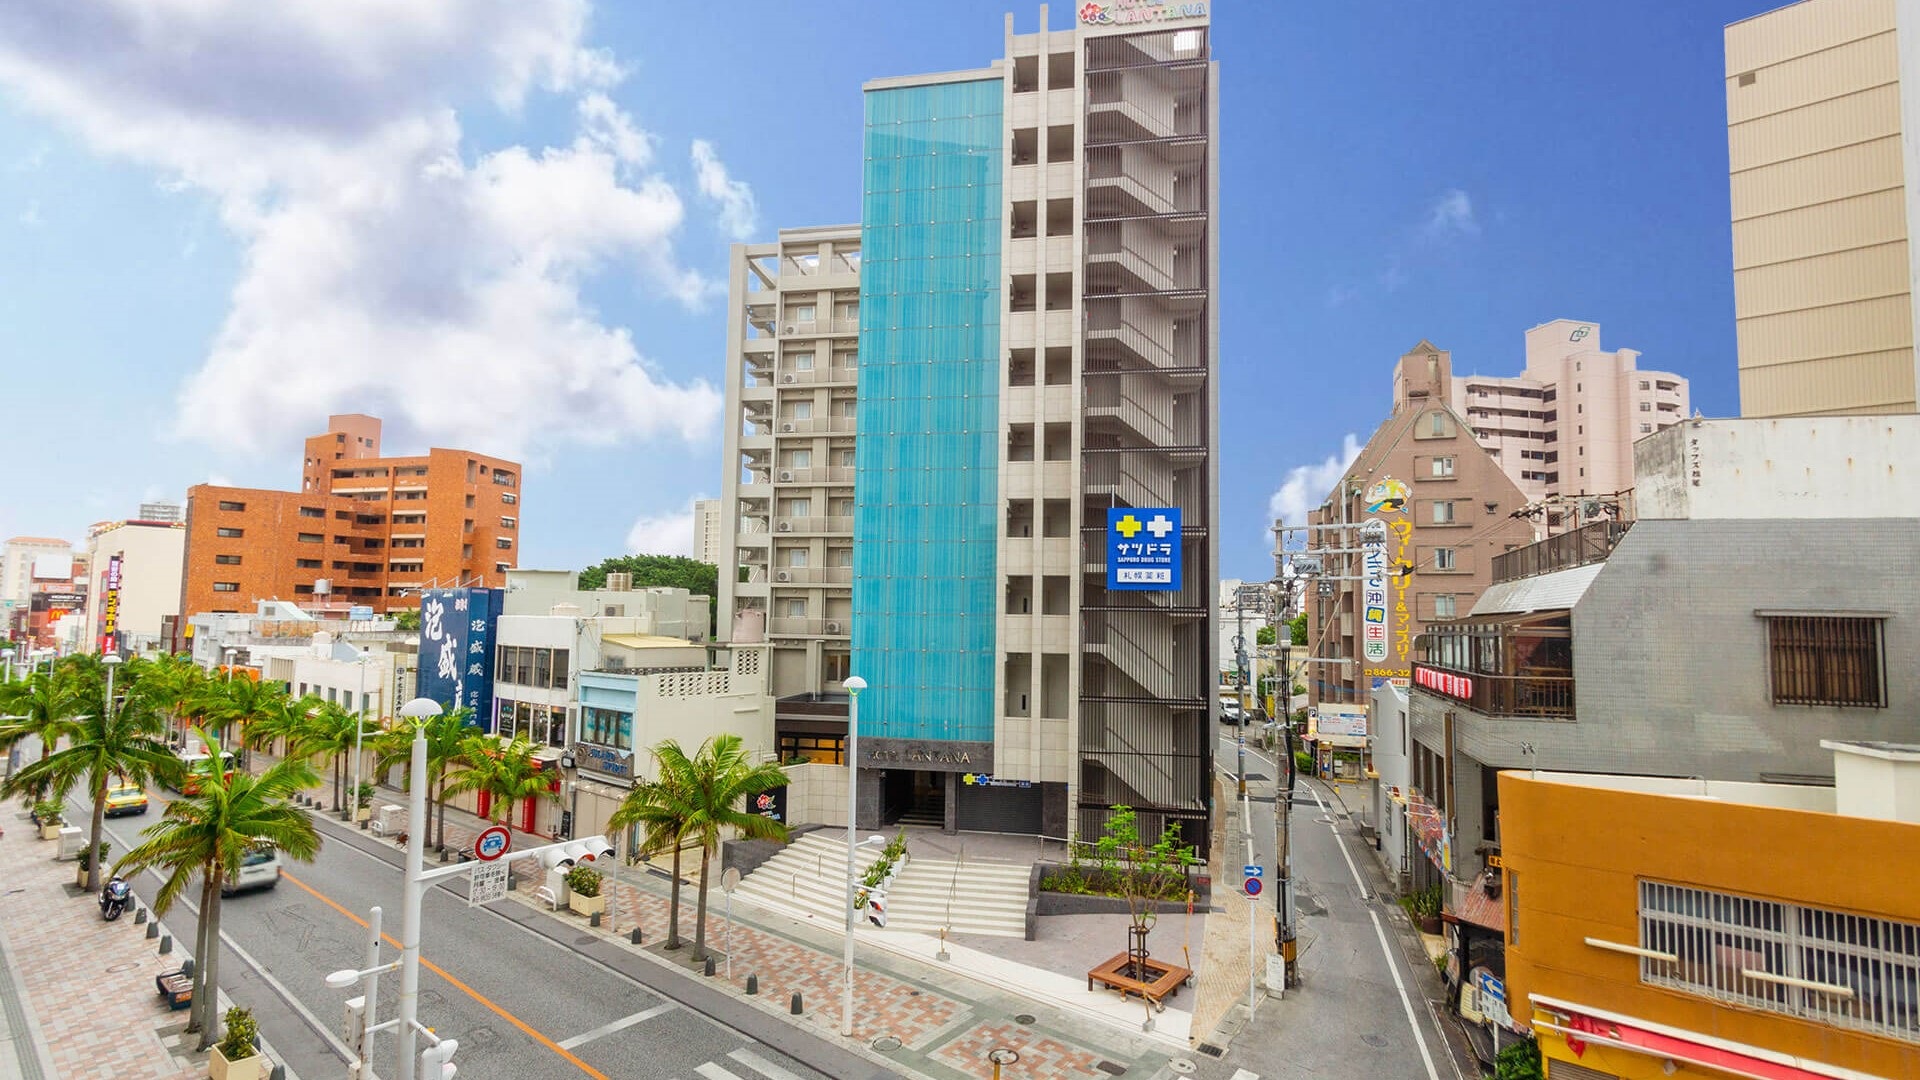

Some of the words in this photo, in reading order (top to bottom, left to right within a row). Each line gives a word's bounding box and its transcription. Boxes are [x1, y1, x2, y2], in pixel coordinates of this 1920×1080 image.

[1115, 3, 1207, 24] LANTANA
[1117, 543, 1171, 555] サツドラ
